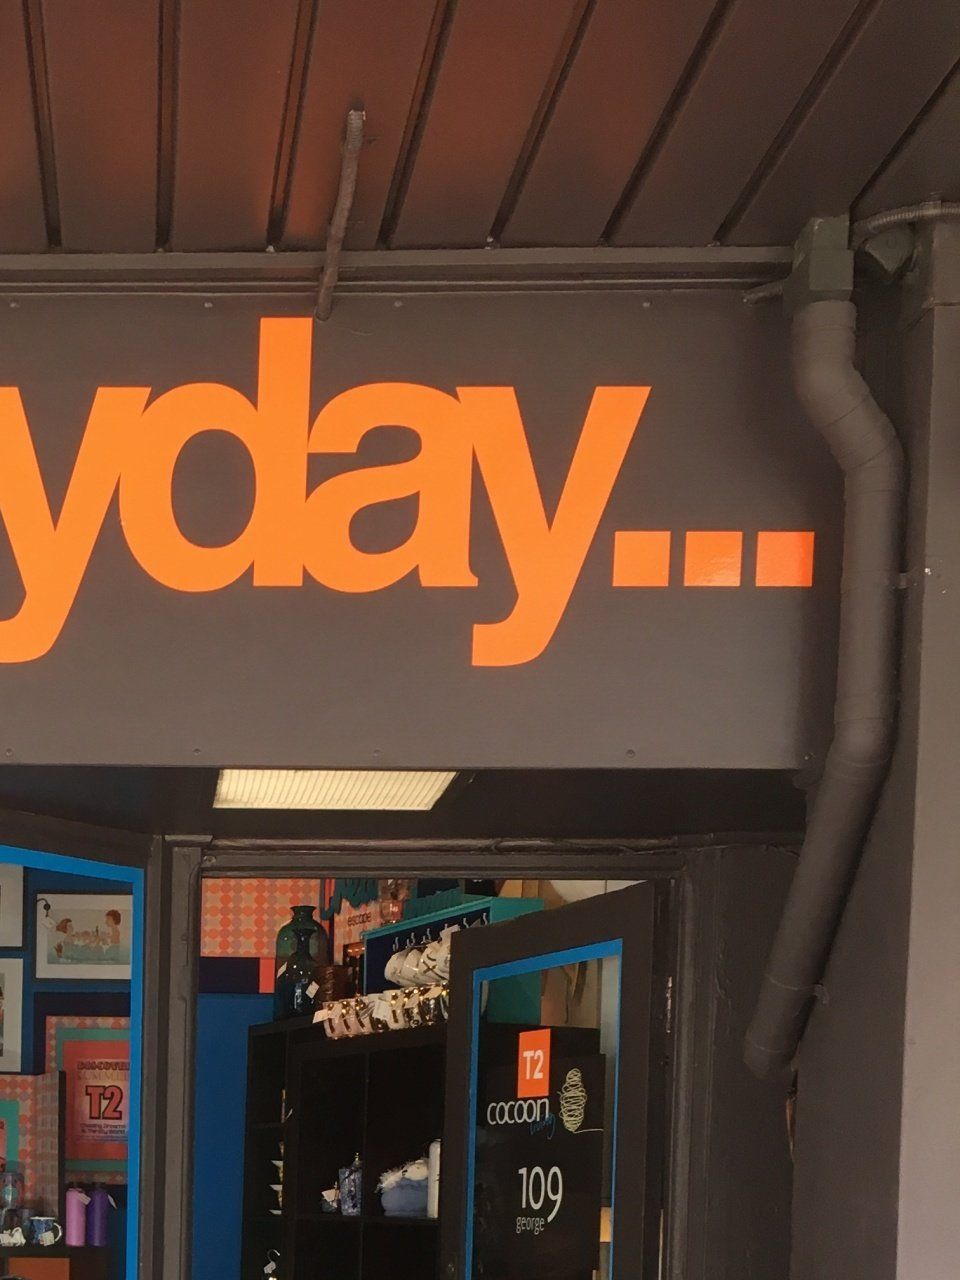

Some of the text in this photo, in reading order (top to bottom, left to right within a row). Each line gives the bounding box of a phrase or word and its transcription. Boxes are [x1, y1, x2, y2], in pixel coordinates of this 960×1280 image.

[523, 1049, 544, 1080] T2
[85, 1084, 124, 1121] T2
[486, 1098, 550, 1126] cocoon
[517, 1165, 564, 1224] 109
[515, 1215, 545, 1236] george
